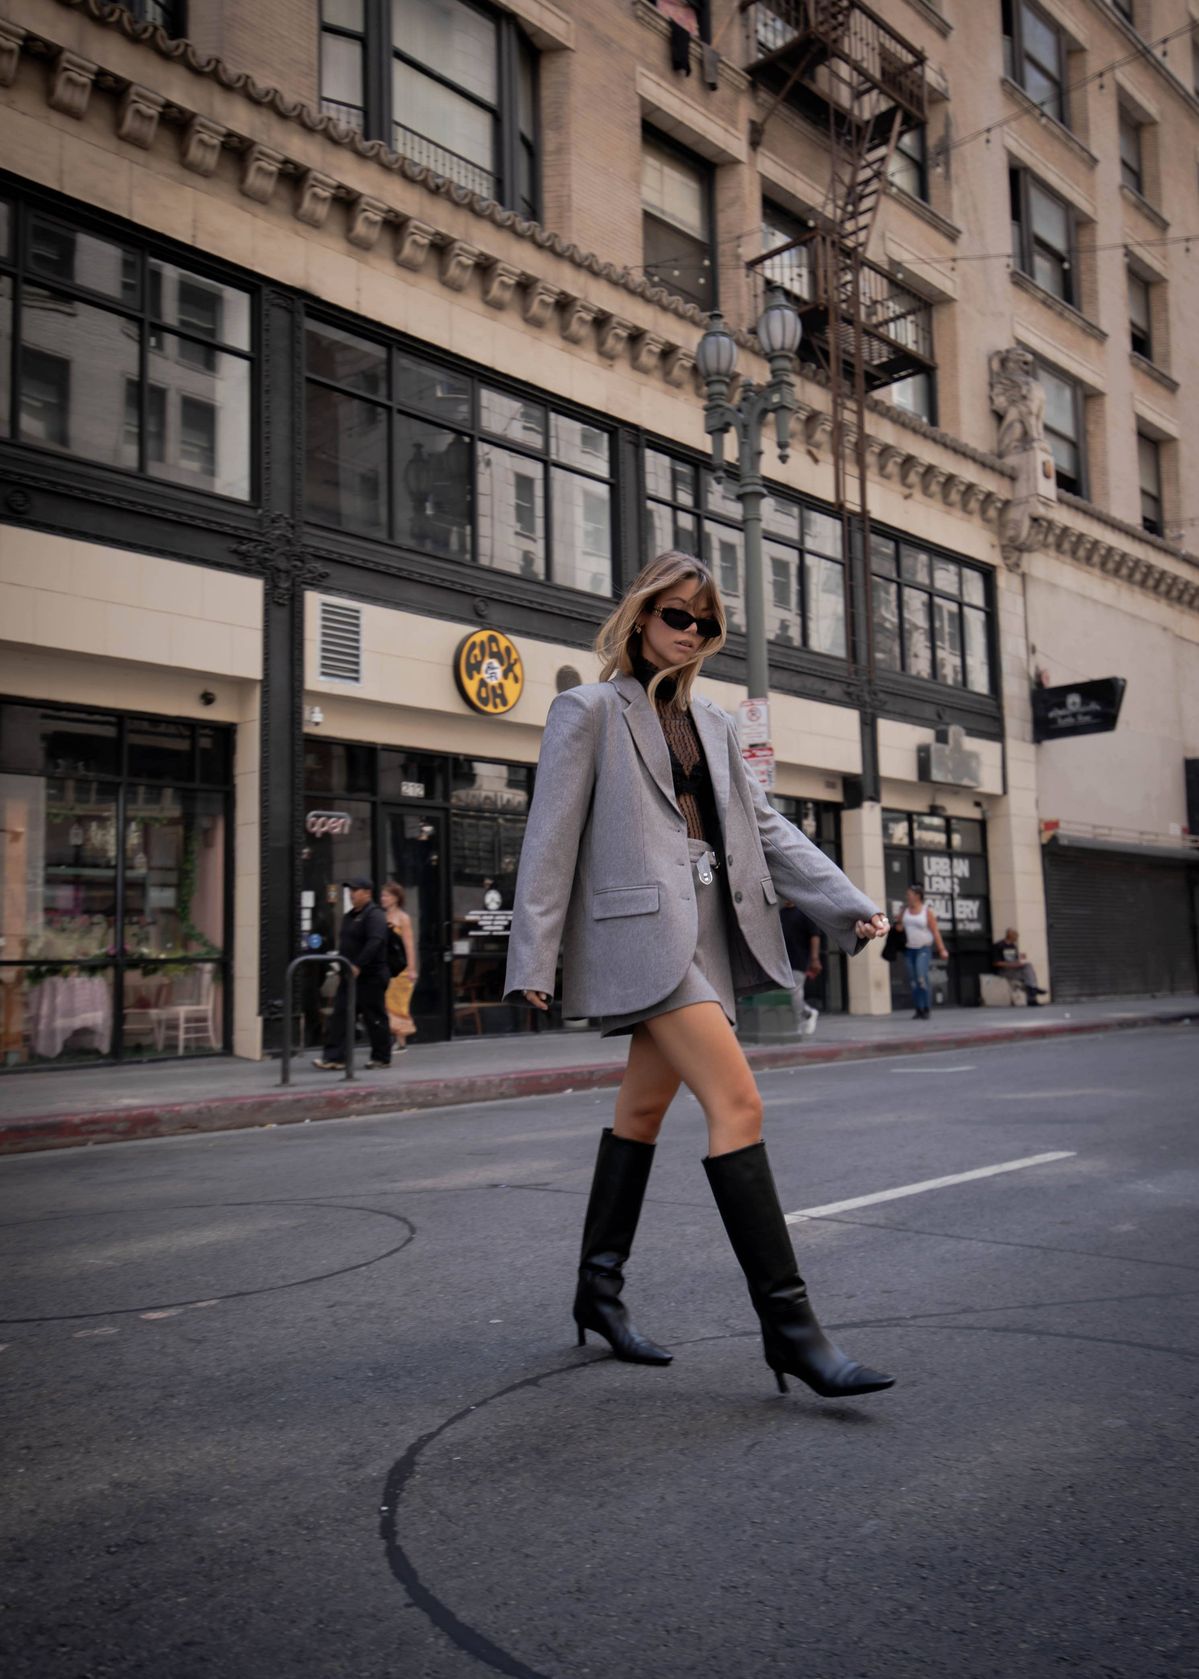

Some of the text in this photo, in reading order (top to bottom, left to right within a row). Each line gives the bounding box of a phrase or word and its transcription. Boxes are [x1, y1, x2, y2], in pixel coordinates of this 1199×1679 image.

[477, 678, 508, 709] OH
[923, 856, 970, 878] URBAN
[924, 876, 960, 895] LENS
